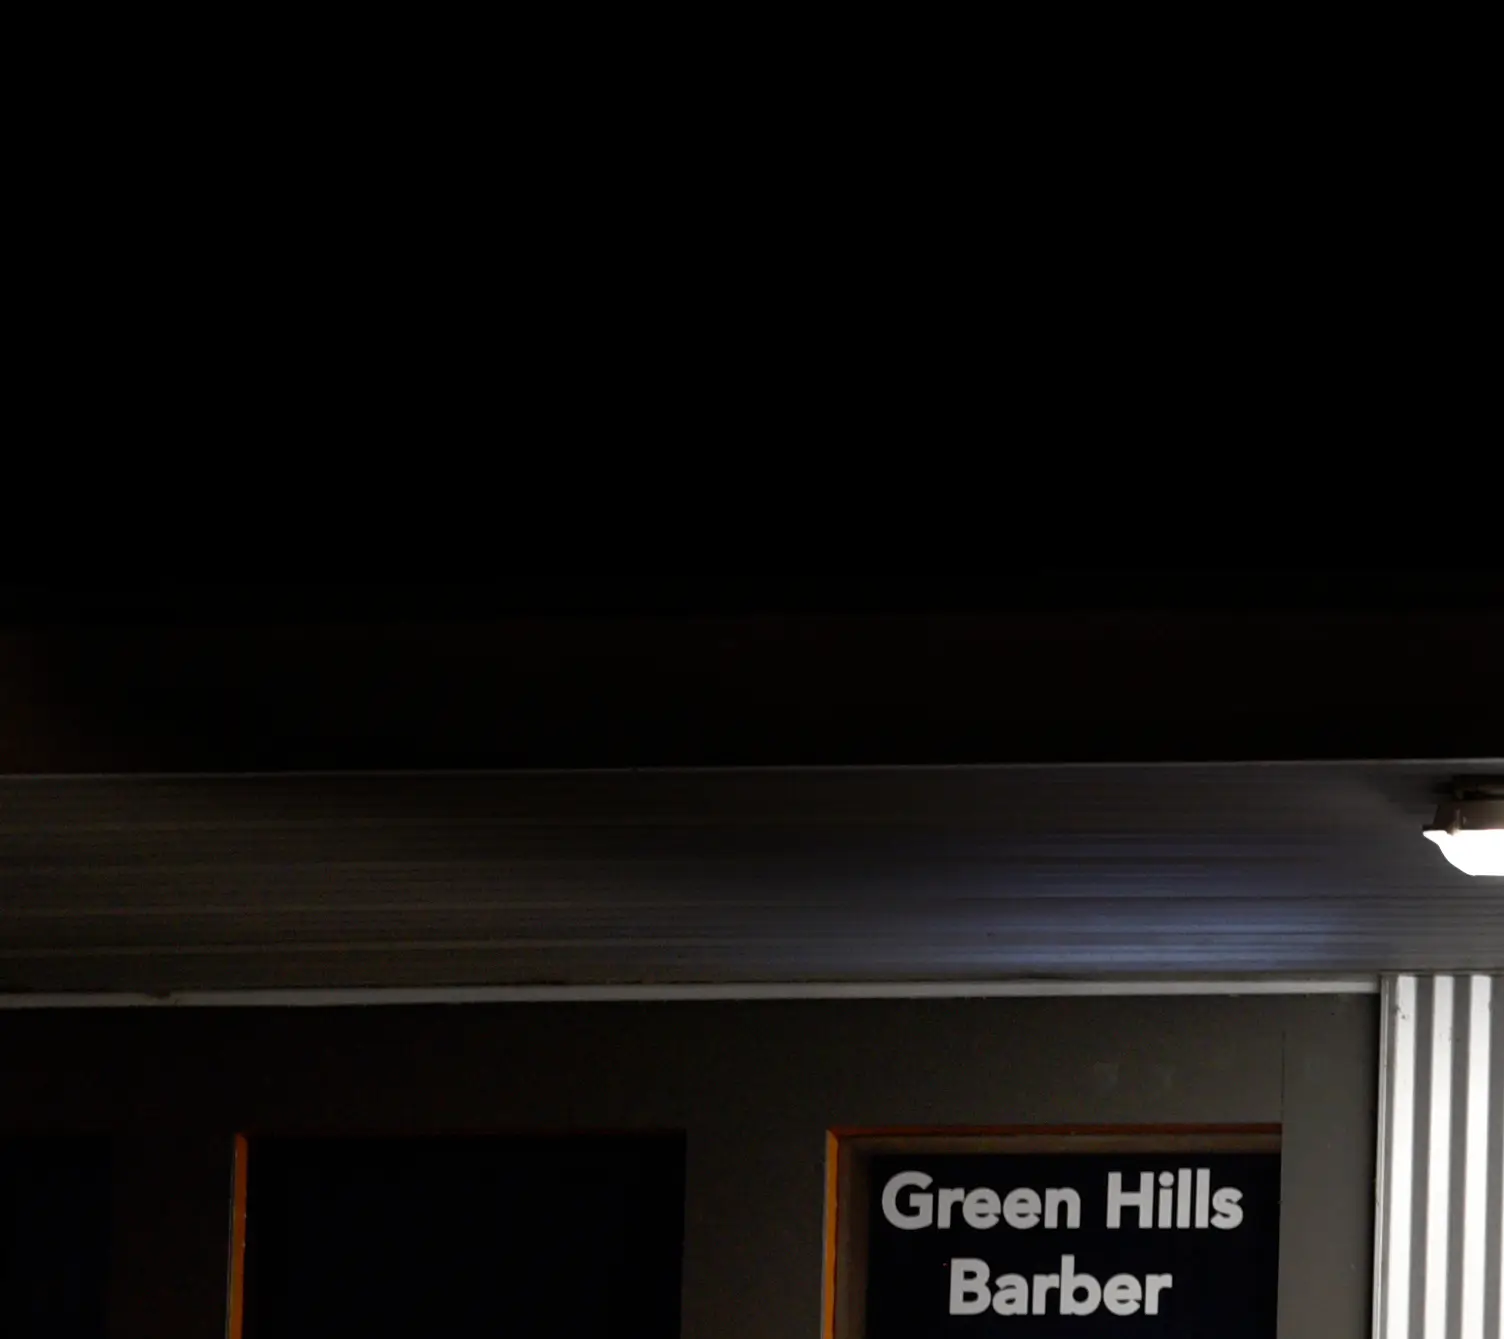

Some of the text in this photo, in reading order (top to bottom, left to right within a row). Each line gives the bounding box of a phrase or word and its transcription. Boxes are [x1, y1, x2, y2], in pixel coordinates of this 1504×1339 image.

[881, 1168, 1244, 1230] Green Hills
[949, 1253, 1173, 1316] Barber
